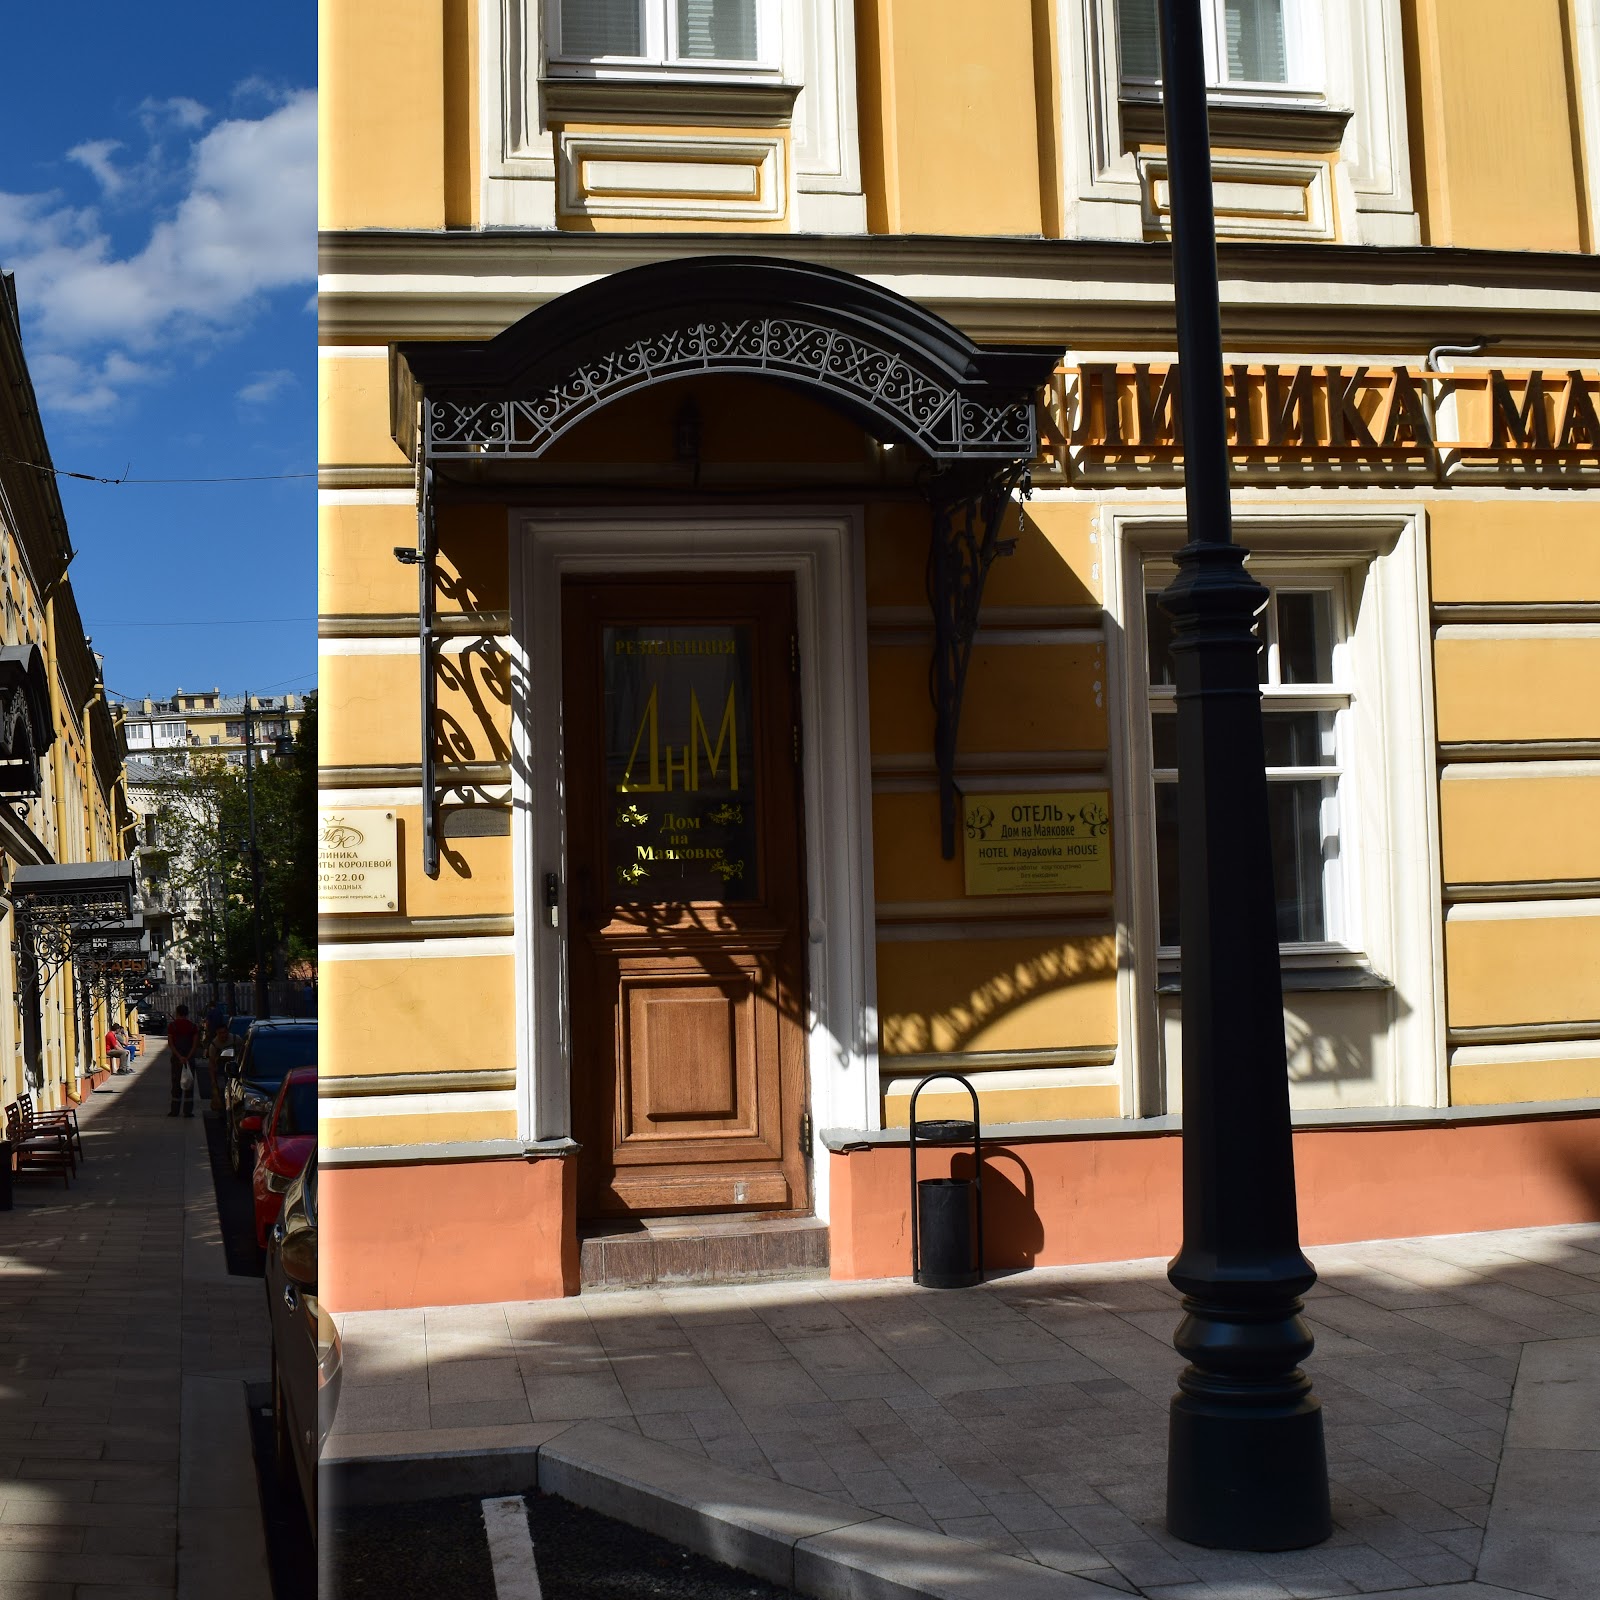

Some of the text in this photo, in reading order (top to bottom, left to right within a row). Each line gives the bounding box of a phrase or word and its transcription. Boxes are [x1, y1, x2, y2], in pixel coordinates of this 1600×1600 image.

[615, 640, 735, 656] РЕЗИДЕНЦИЯ
[1011, 805, 1063, 822] ОТЕЛЬ
[660, 813, 701, 832] Дом
[1001, 824, 1075, 839] Дом на Маяковке
[670, 835, 688, 845] на
[318, 851, 358, 859] ЛИНИКА
[636, 846, 724, 860] Маяковке
[979, 845, 1098, 859] HOTEL Mayakovka HOUSE
[338, 859, 392, 869] КОРОЛЕВОЙ
